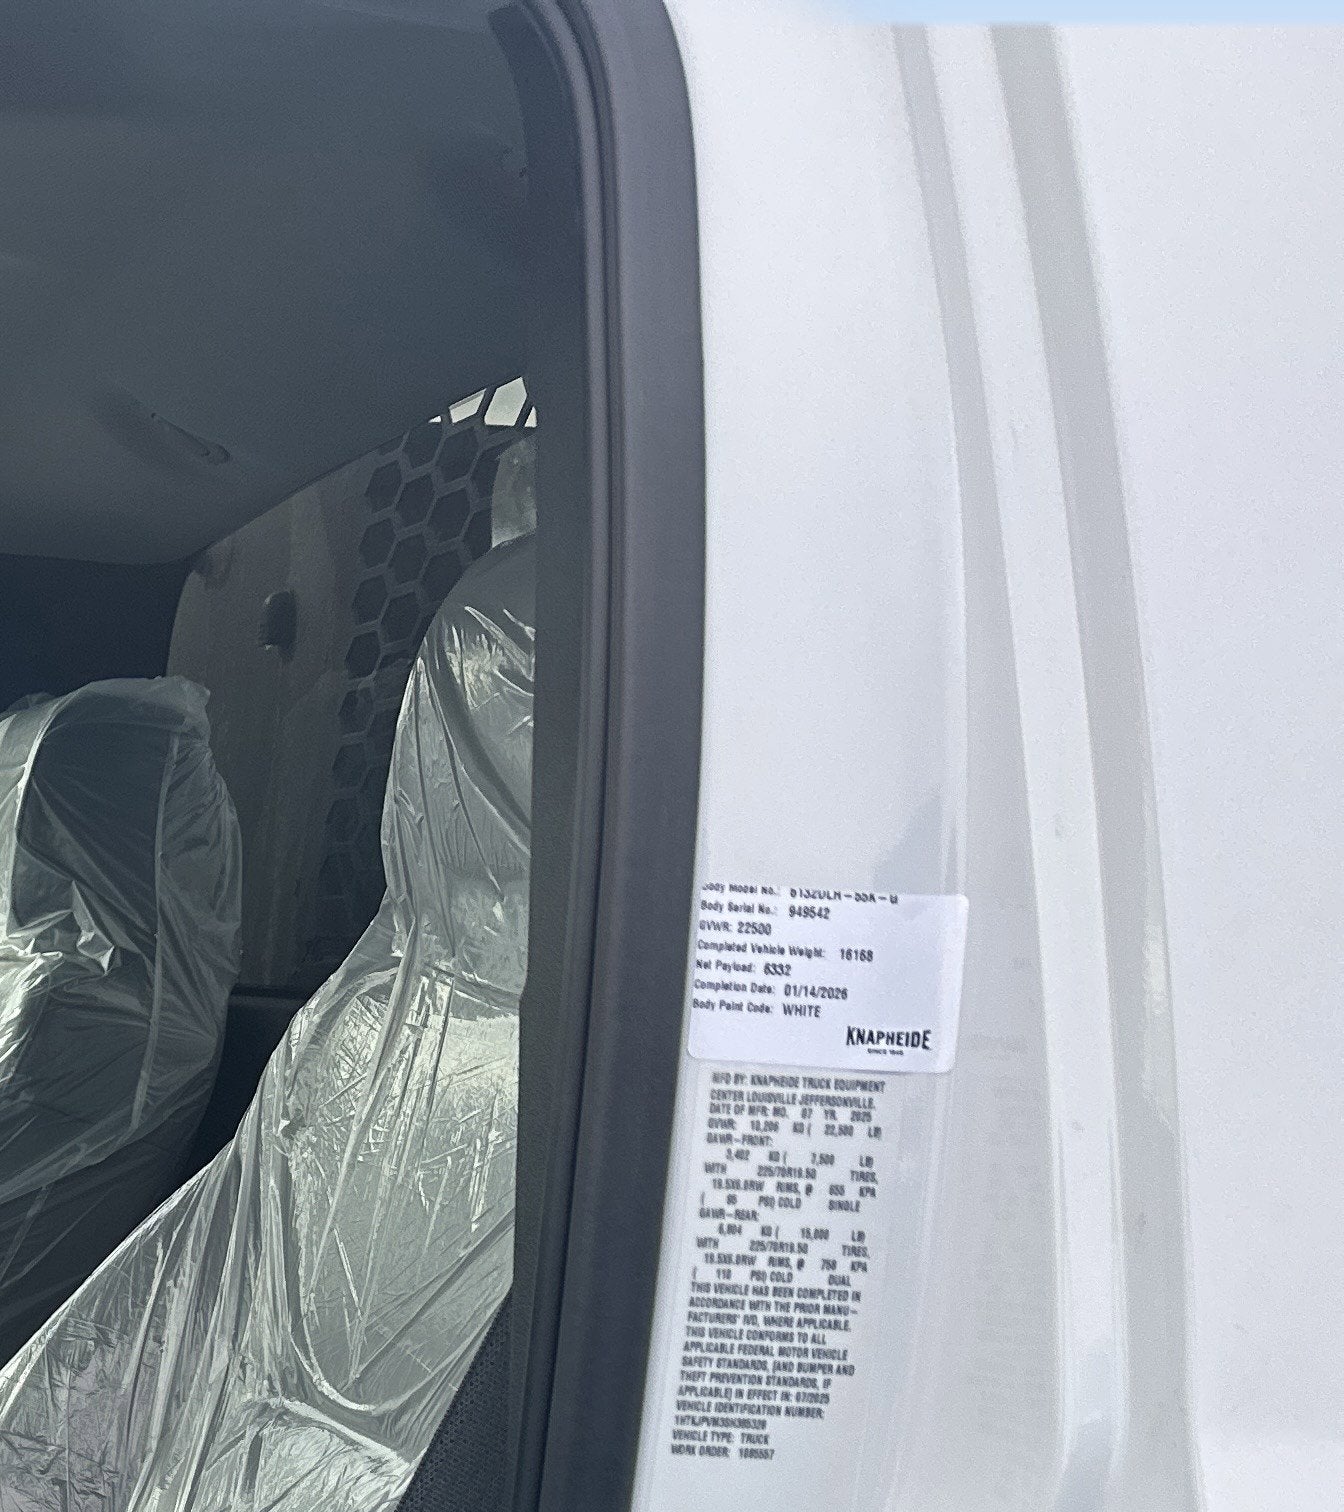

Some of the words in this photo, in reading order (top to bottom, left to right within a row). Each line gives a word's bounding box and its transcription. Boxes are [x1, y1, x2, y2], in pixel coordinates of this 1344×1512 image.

[737, 921, 772, 935] 22500
[698, 940, 747, 953] Completed
[750, 943, 785, 955] Vehicle
[788, 945, 825, 959] Weight:
[840, 948, 873, 962] 16168
[696, 959, 712, 970] Net
[715, 960, 755, 973] Payload:
[694, 979, 747, 992] Completion
[750, 982, 775, 995] Date:
[784, 983, 849, 1000] 01/14/2026
[693, 998, 715, 1011] Body
[719, 1000, 744, 1012] Paint
[747, 1002, 772, 1014] Code:
[783, 1003, 821, 1018] WHITE
[846, 1026, 931, 1050] KNAPHEIDE
[751, 1074, 799, 1089] KNAPHEIDE
[802, 1076, 831, 1090] TRUCK
[834, 1078, 886, 1093] EQUIPMENT
[691, 1281, 711, 1294] THIS
[714, 1283, 749, 1296] VEHICLE
[797, 1287, 849, 1301] COMPLETED
[774, 1300, 790, 1313] THE
[686, 1325, 705, 1338] THIS
[709, 1327, 744, 1340] VEHICLE
[746, 1329, 794, 1343] CONFORMS
[798, 1332, 808, 1344] TO
[811, 1332, 826, 1345] ALL
[683, 1341, 735, 1354] APPLICABLE
[738, 1344, 774, 1358] FEDERAL
[778, 1346, 809, 1358] MOTOR
[812, 1348, 848, 1361] VEHICLE
[682, 1356, 714, 1368] SAFETY
[680, 1369, 707, 1382] THEFT
[710, 1372, 763, 1386] PREVENTION
[747, 1388, 778, 1401] EFFECT
[676, 1400, 711, 1413] VEHICLE
[714, 1401, 782, 1416] IDENTIFICATION
[672, 1429, 707, 1442] VEHICLE
[740, 1432, 769, 1445] TRUCK
[671, 1443, 696, 1456] WORK
